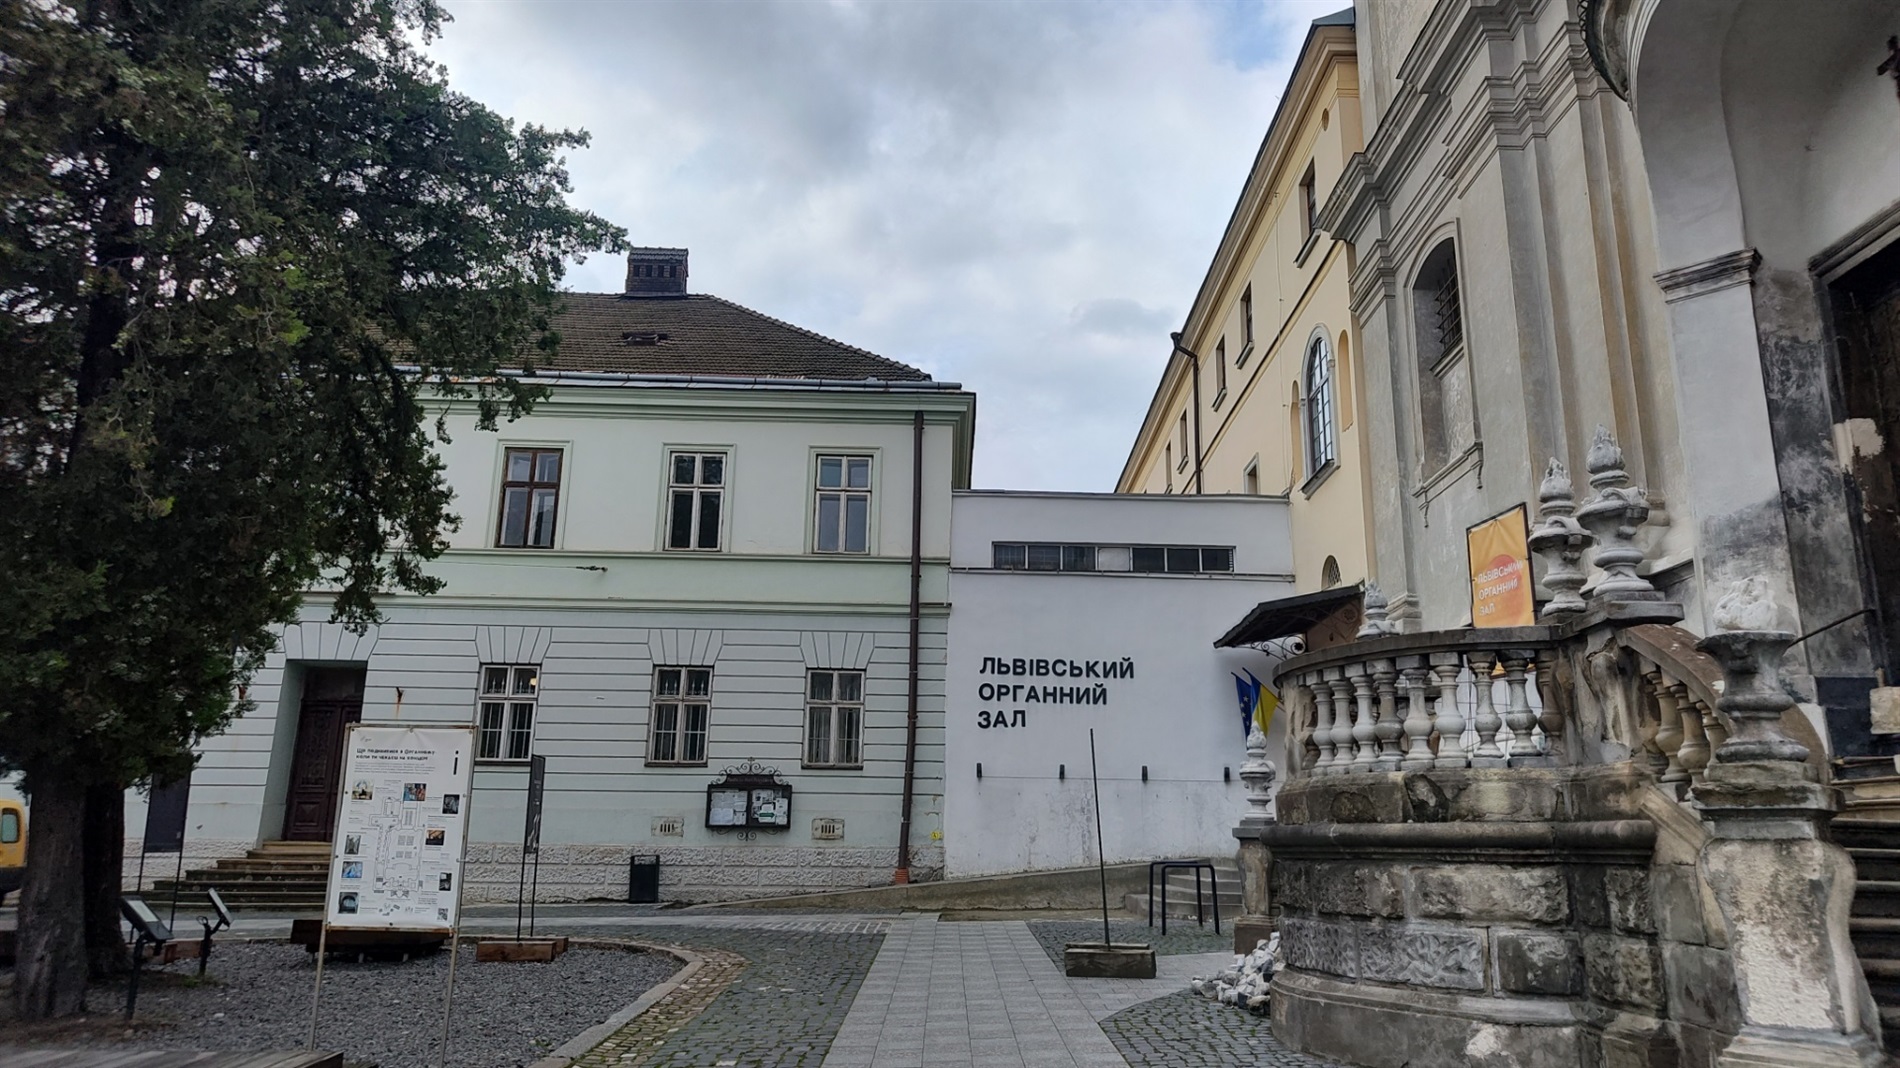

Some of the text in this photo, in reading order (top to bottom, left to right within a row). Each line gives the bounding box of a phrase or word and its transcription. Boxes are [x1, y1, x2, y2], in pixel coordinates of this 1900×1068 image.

[1479, 576, 1517, 600] ОРГАННИЙ
[1479, 603, 1495, 616] ЗАЛ
[979, 657, 1135, 679] ЛЬВІВСЬКИЙ
[978, 683, 1107, 705] ОРГАННИЙ
[977, 709, 1027, 729] ЗАЛ
